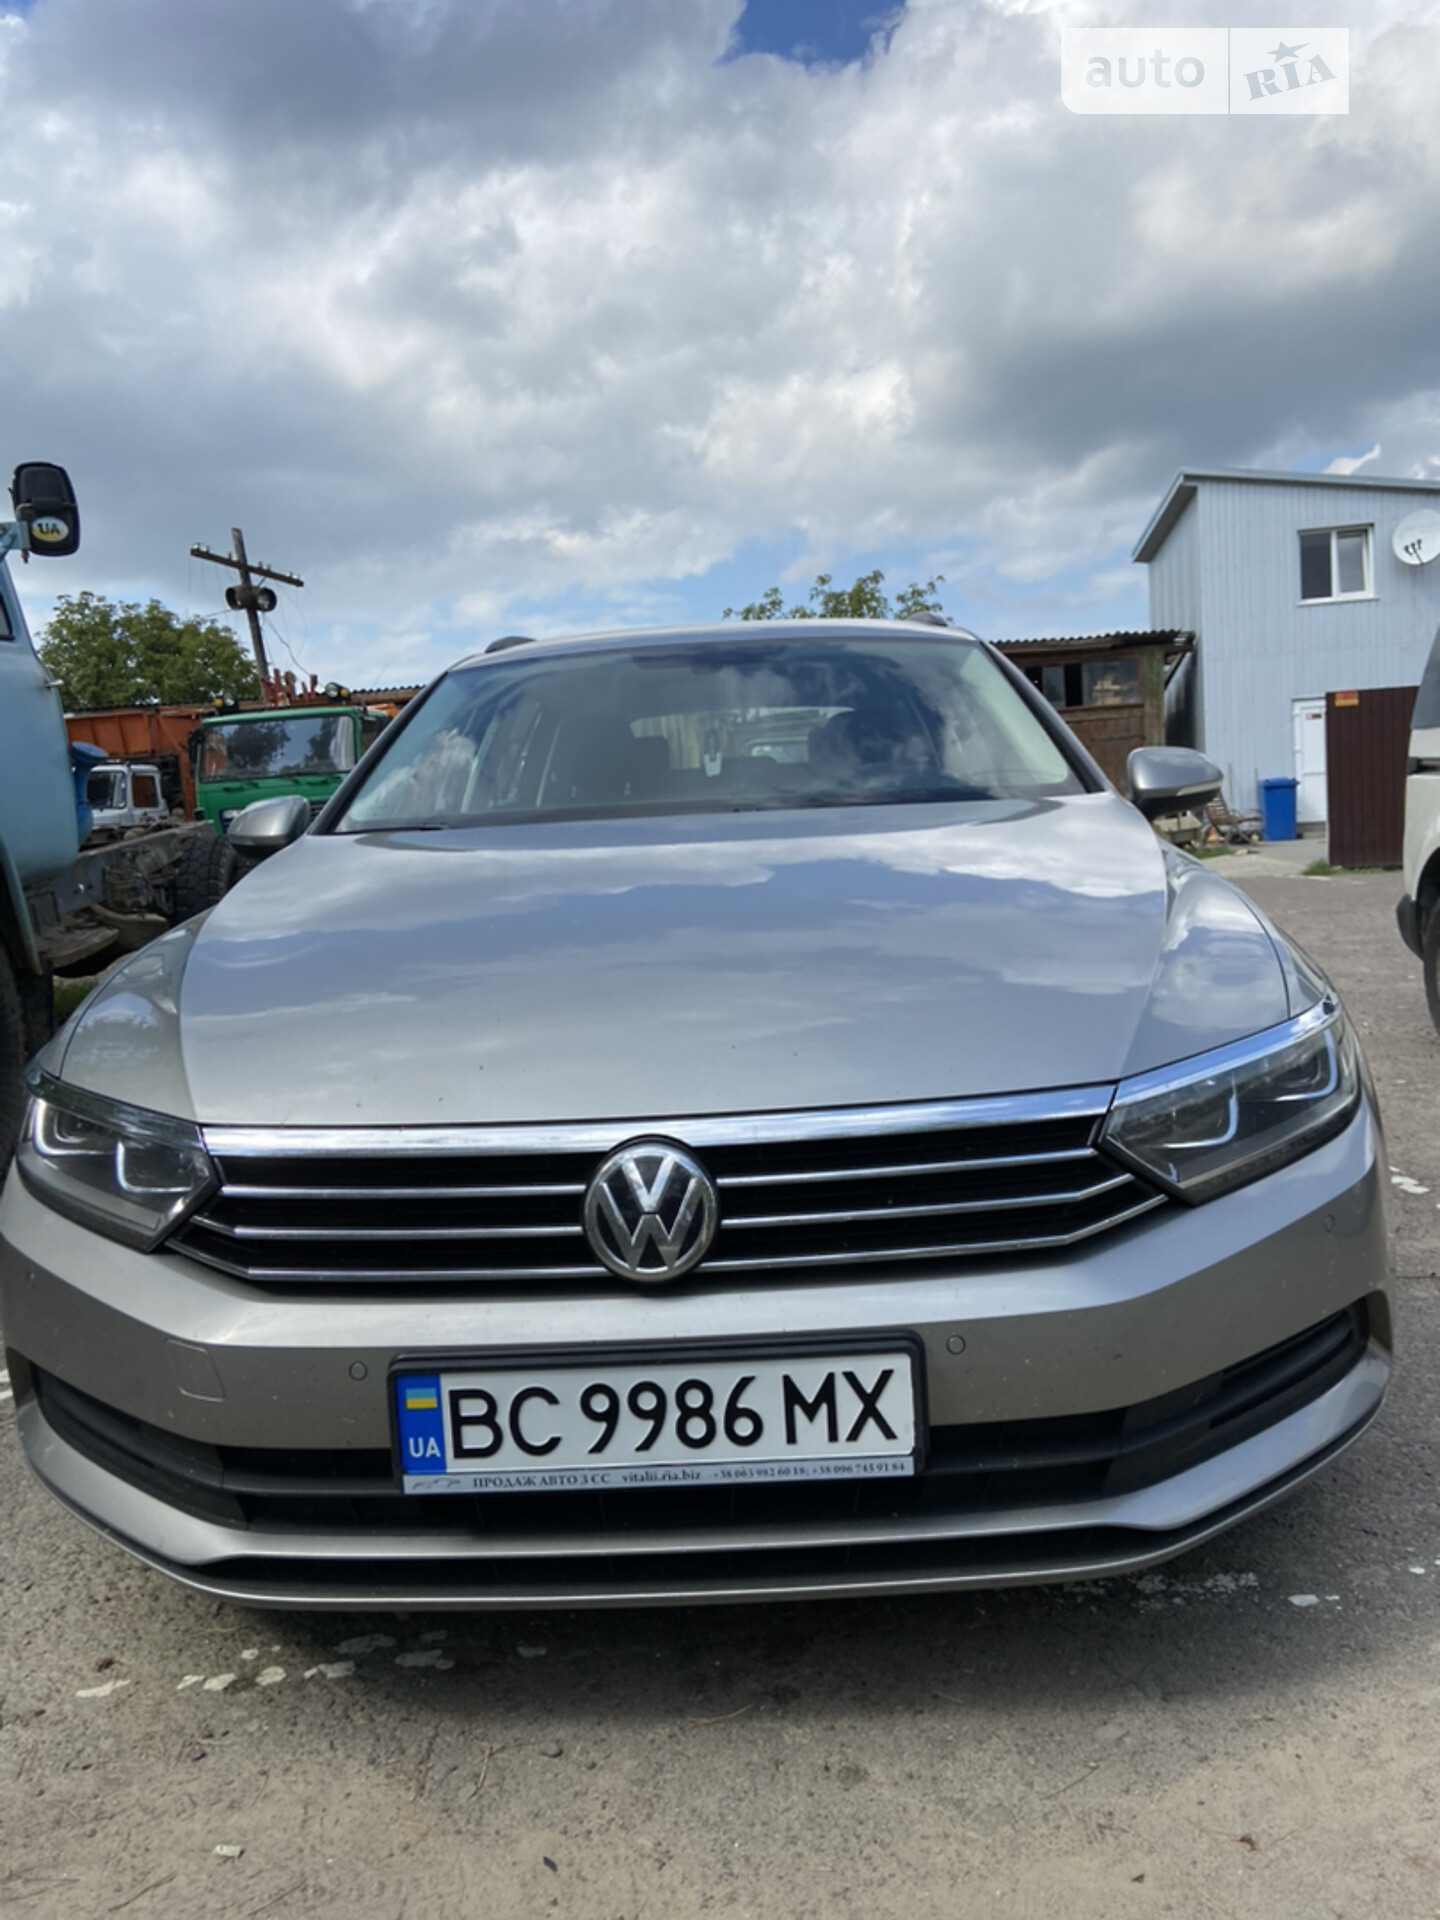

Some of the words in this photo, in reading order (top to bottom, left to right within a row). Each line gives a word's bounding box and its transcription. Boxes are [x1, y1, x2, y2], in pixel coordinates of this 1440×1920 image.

[37, 522, 61, 535] UA
[448, 1386, 563, 1460] BC
[579, 1376, 764, 1454] 9986
[781, 1368, 898, 1446] MX
[408, 1436, 442, 1459] UA
[472, 1476, 537, 1488] ПРОДАЖ
[540, 1474, 579, 1486] АВТО
